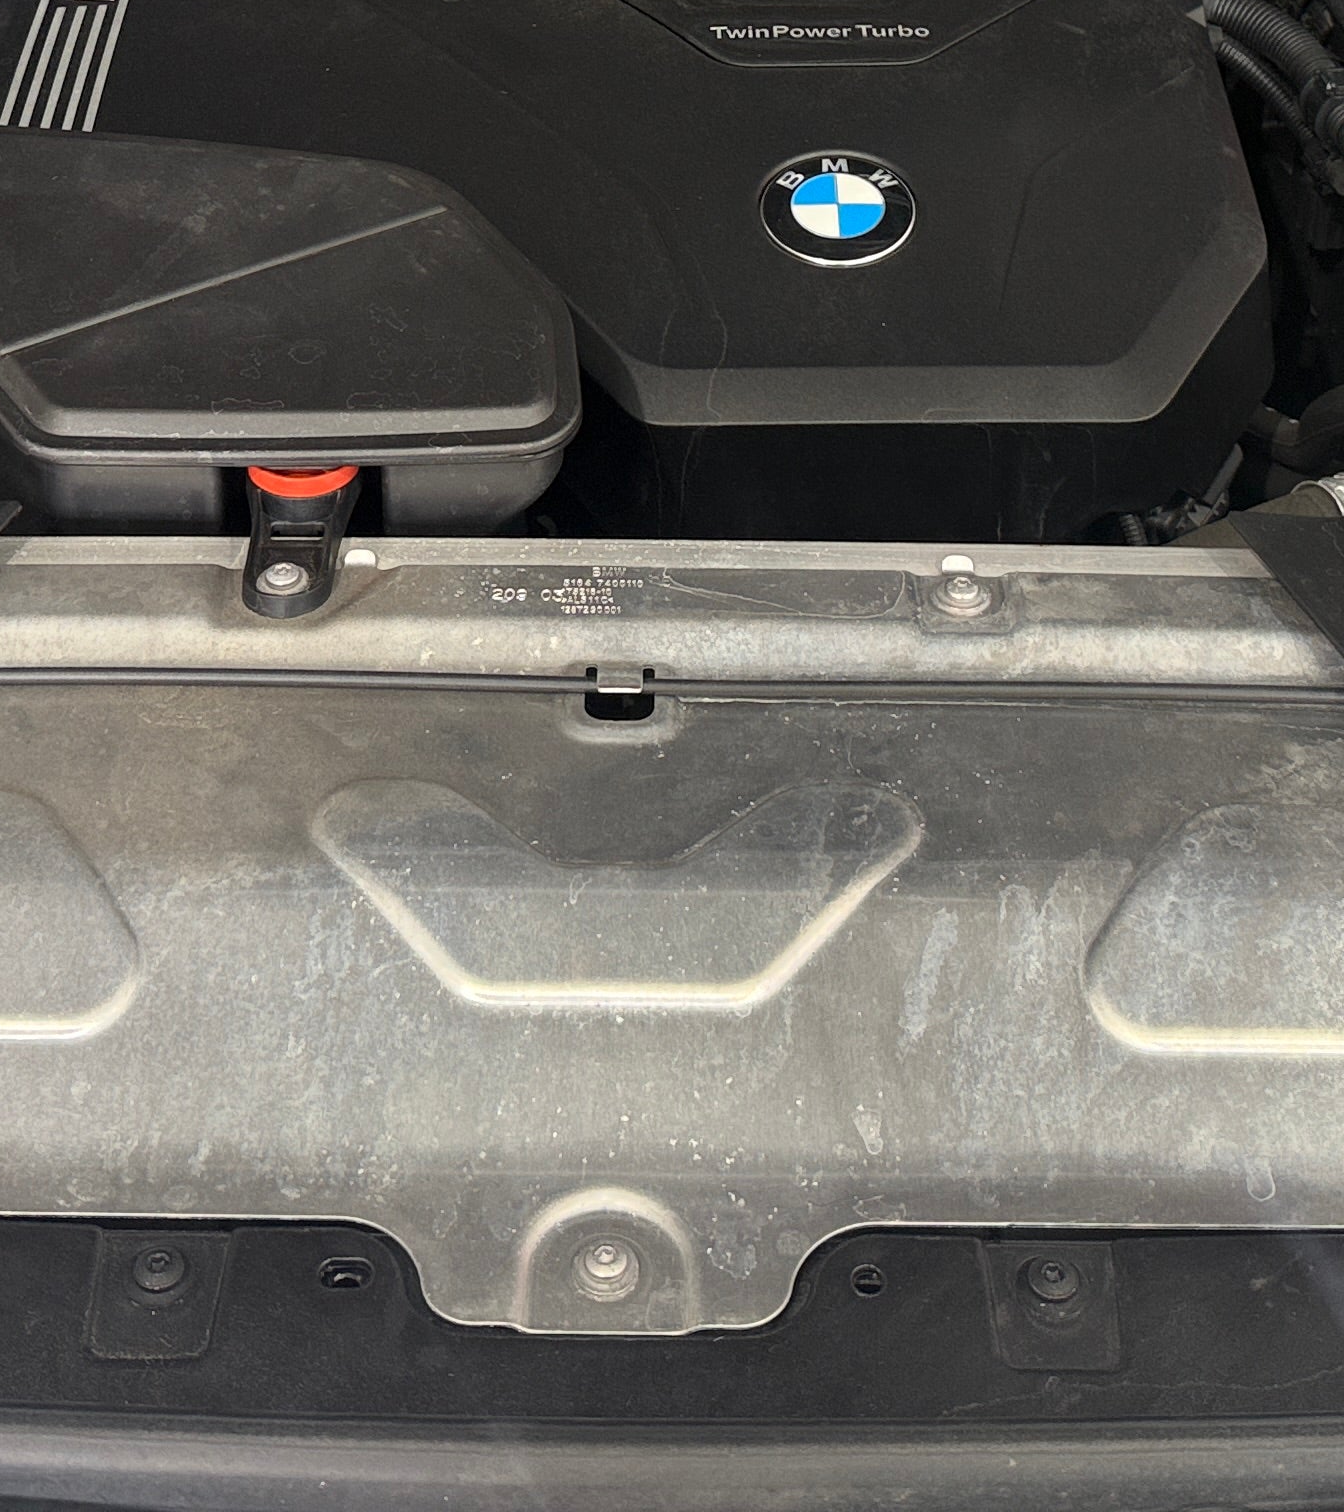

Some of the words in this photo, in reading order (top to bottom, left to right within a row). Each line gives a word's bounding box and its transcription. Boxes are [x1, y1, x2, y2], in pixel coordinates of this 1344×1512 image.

[709, 24, 852, 40] TwinPower
[855, 23, 931, 38] Turbo
[776, 158, 900, 191] BMW
[592, 566, 627, 578] BMW
